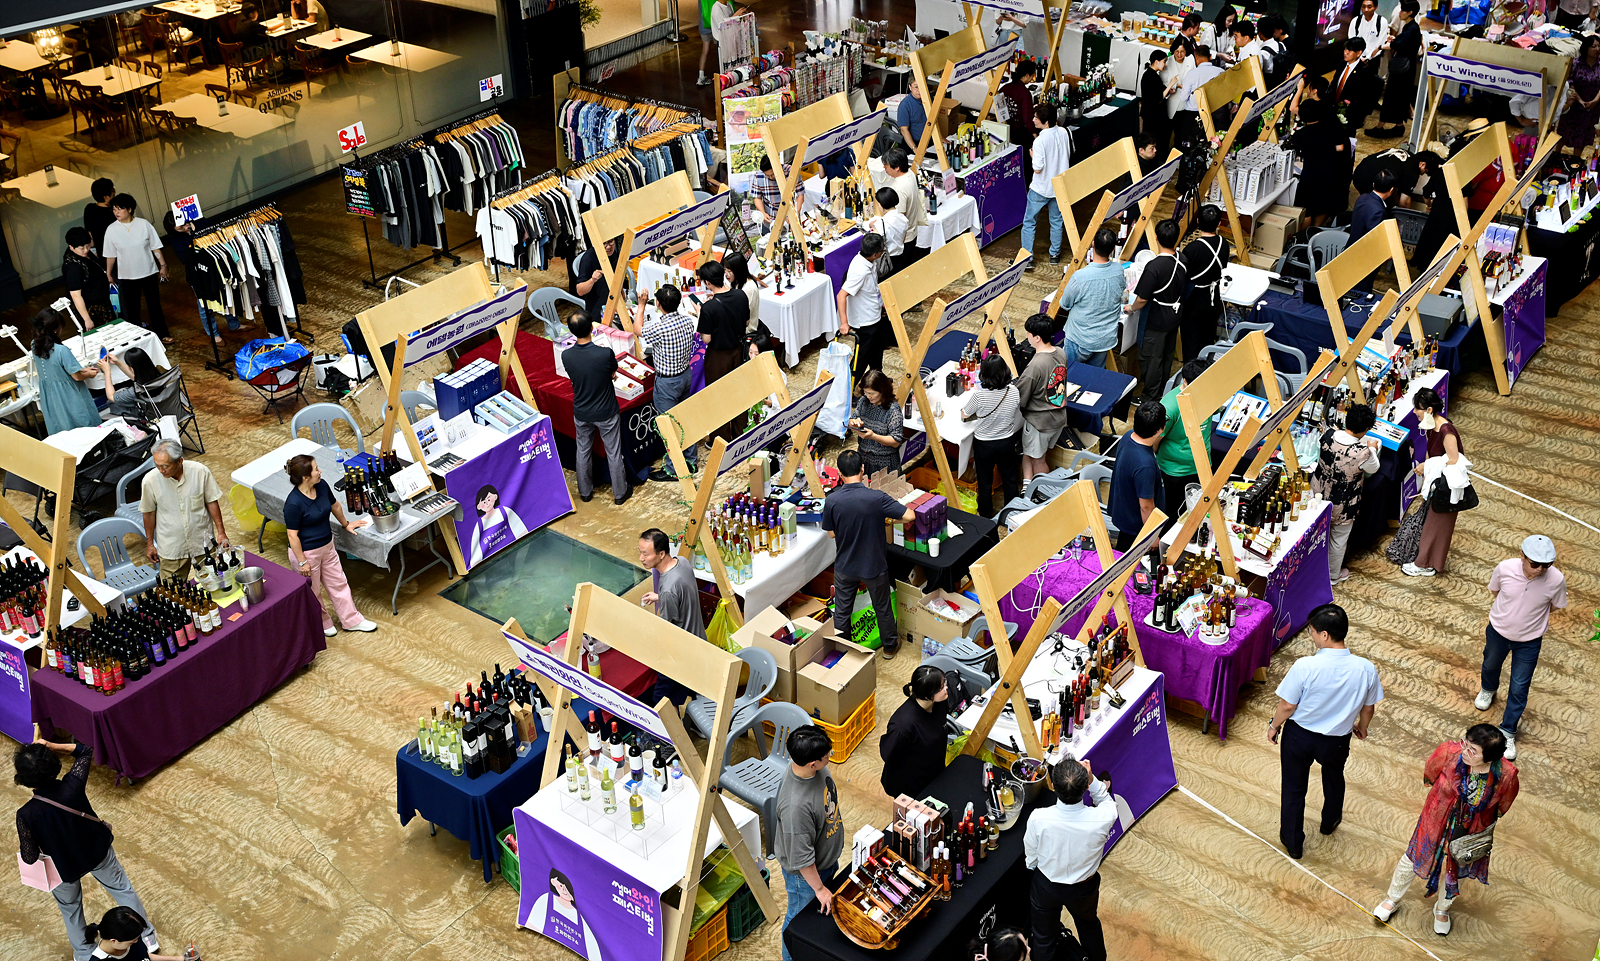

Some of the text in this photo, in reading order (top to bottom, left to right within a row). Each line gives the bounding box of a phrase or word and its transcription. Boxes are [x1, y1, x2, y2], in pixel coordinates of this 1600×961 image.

[480, 78, 494, 91] 남녀
[1436, 62, 1456, 73] YUL
[1458, 67, 1496, 83] Winery
[259, 90, 303, 113] QUEENS
[267, 86, 291, 99] ASHLEY
[339, 126, 366, 151] Sale
[1236, 172, 1246, 199] SANMAC
[1248, 176, 1258, 203] SANMAC
[644, 224, 675, 245] 여포와인
[946, 270, 1022, 321] GALGISAN WINERY
[518, 427, 548, 453] 썸머와인
[731, 431, 766, 460] 시나브로
[766, 418, 785, 437] 와인
[519, 443, 552, 464] 페스티벌
[1133, 687, 1160, 723] 썸머와인
[1132, 706, 1161, 737] 페스티벌
[611, 880, 654, 914] 썸머와인
[612, 893, 655, 937] 페스티벌
